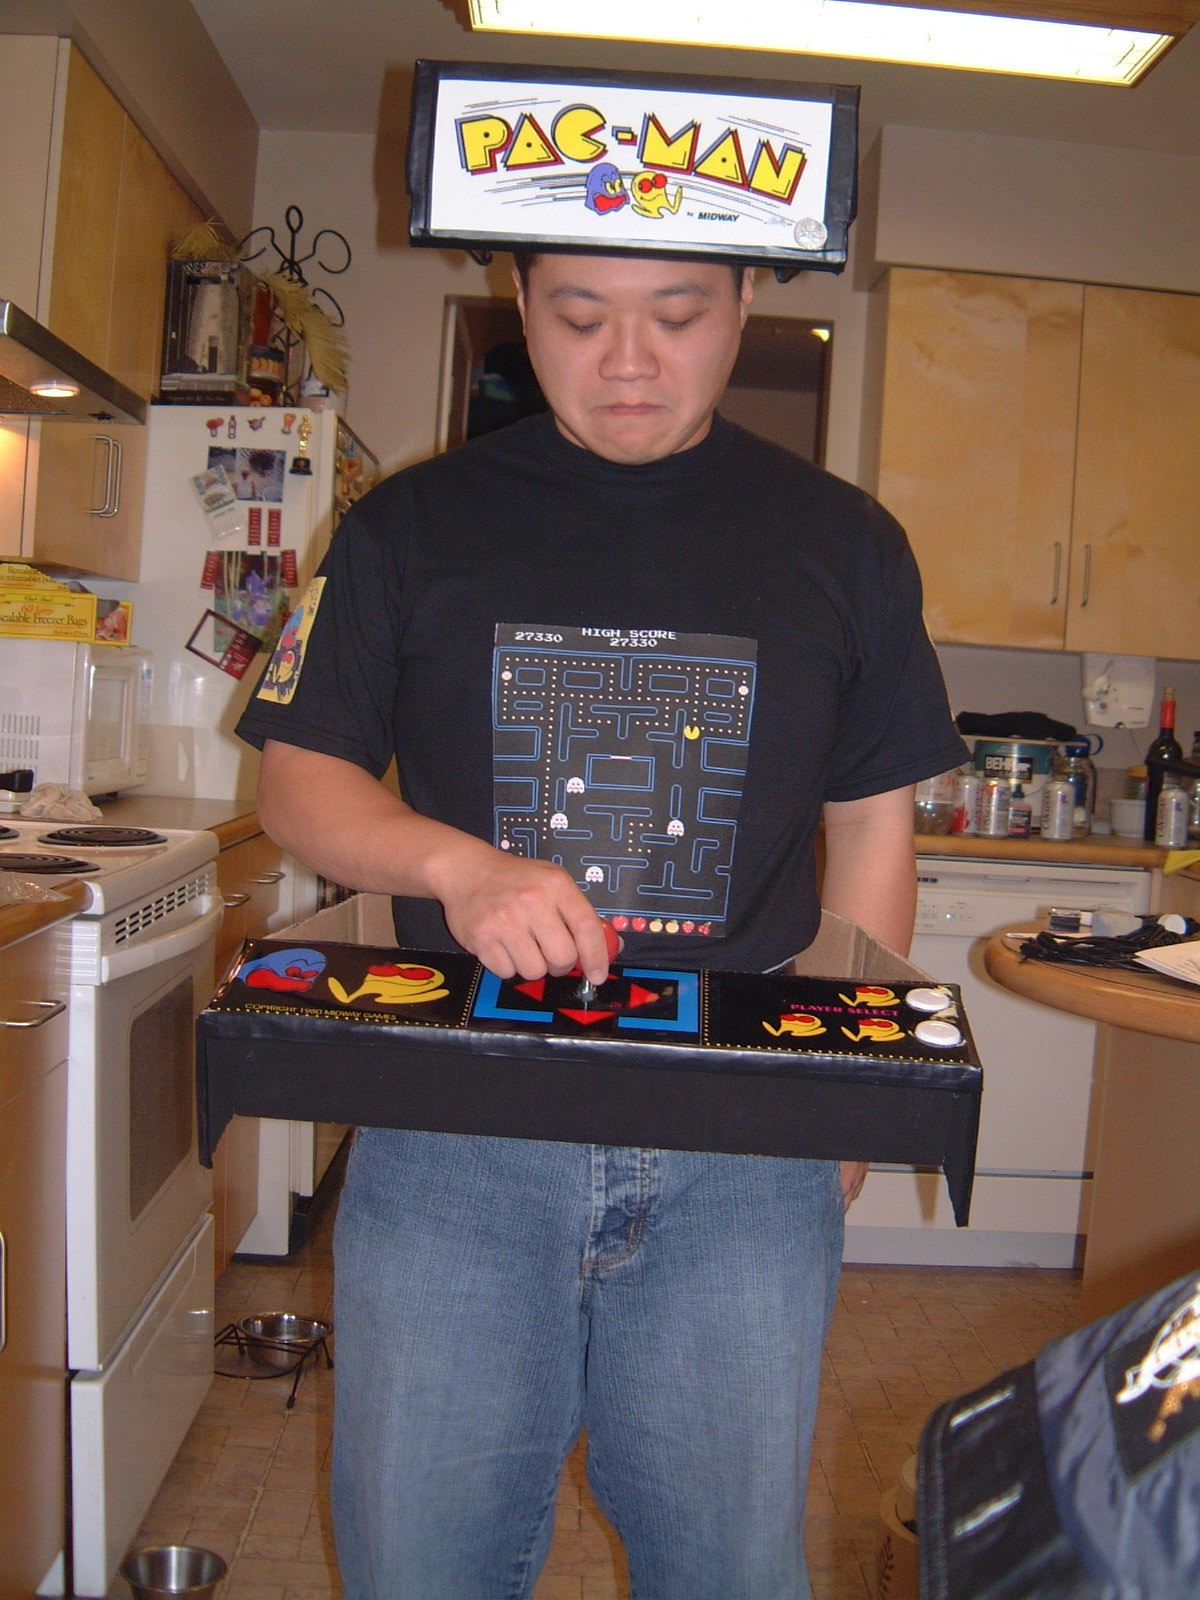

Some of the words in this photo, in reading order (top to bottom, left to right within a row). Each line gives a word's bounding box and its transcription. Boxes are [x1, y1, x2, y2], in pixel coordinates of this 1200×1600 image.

[455, 103, 807, 205] PAC-MAN
[697, 211, 740, 222] MIDWAY
[514, 631, 563, 643] 27330
[581, 627, 621, 639] HIGH
[629, 629, 677, 640] SCORE
[609, 637, 658, 648] 27330
[324, 1009, 361, 1019] MIDWAY
[363, 1012, 397, 1021] GAMES
[789, 1003, 843, 1014] PLAYER
[847, 1006, 900, 1018] SELECT
